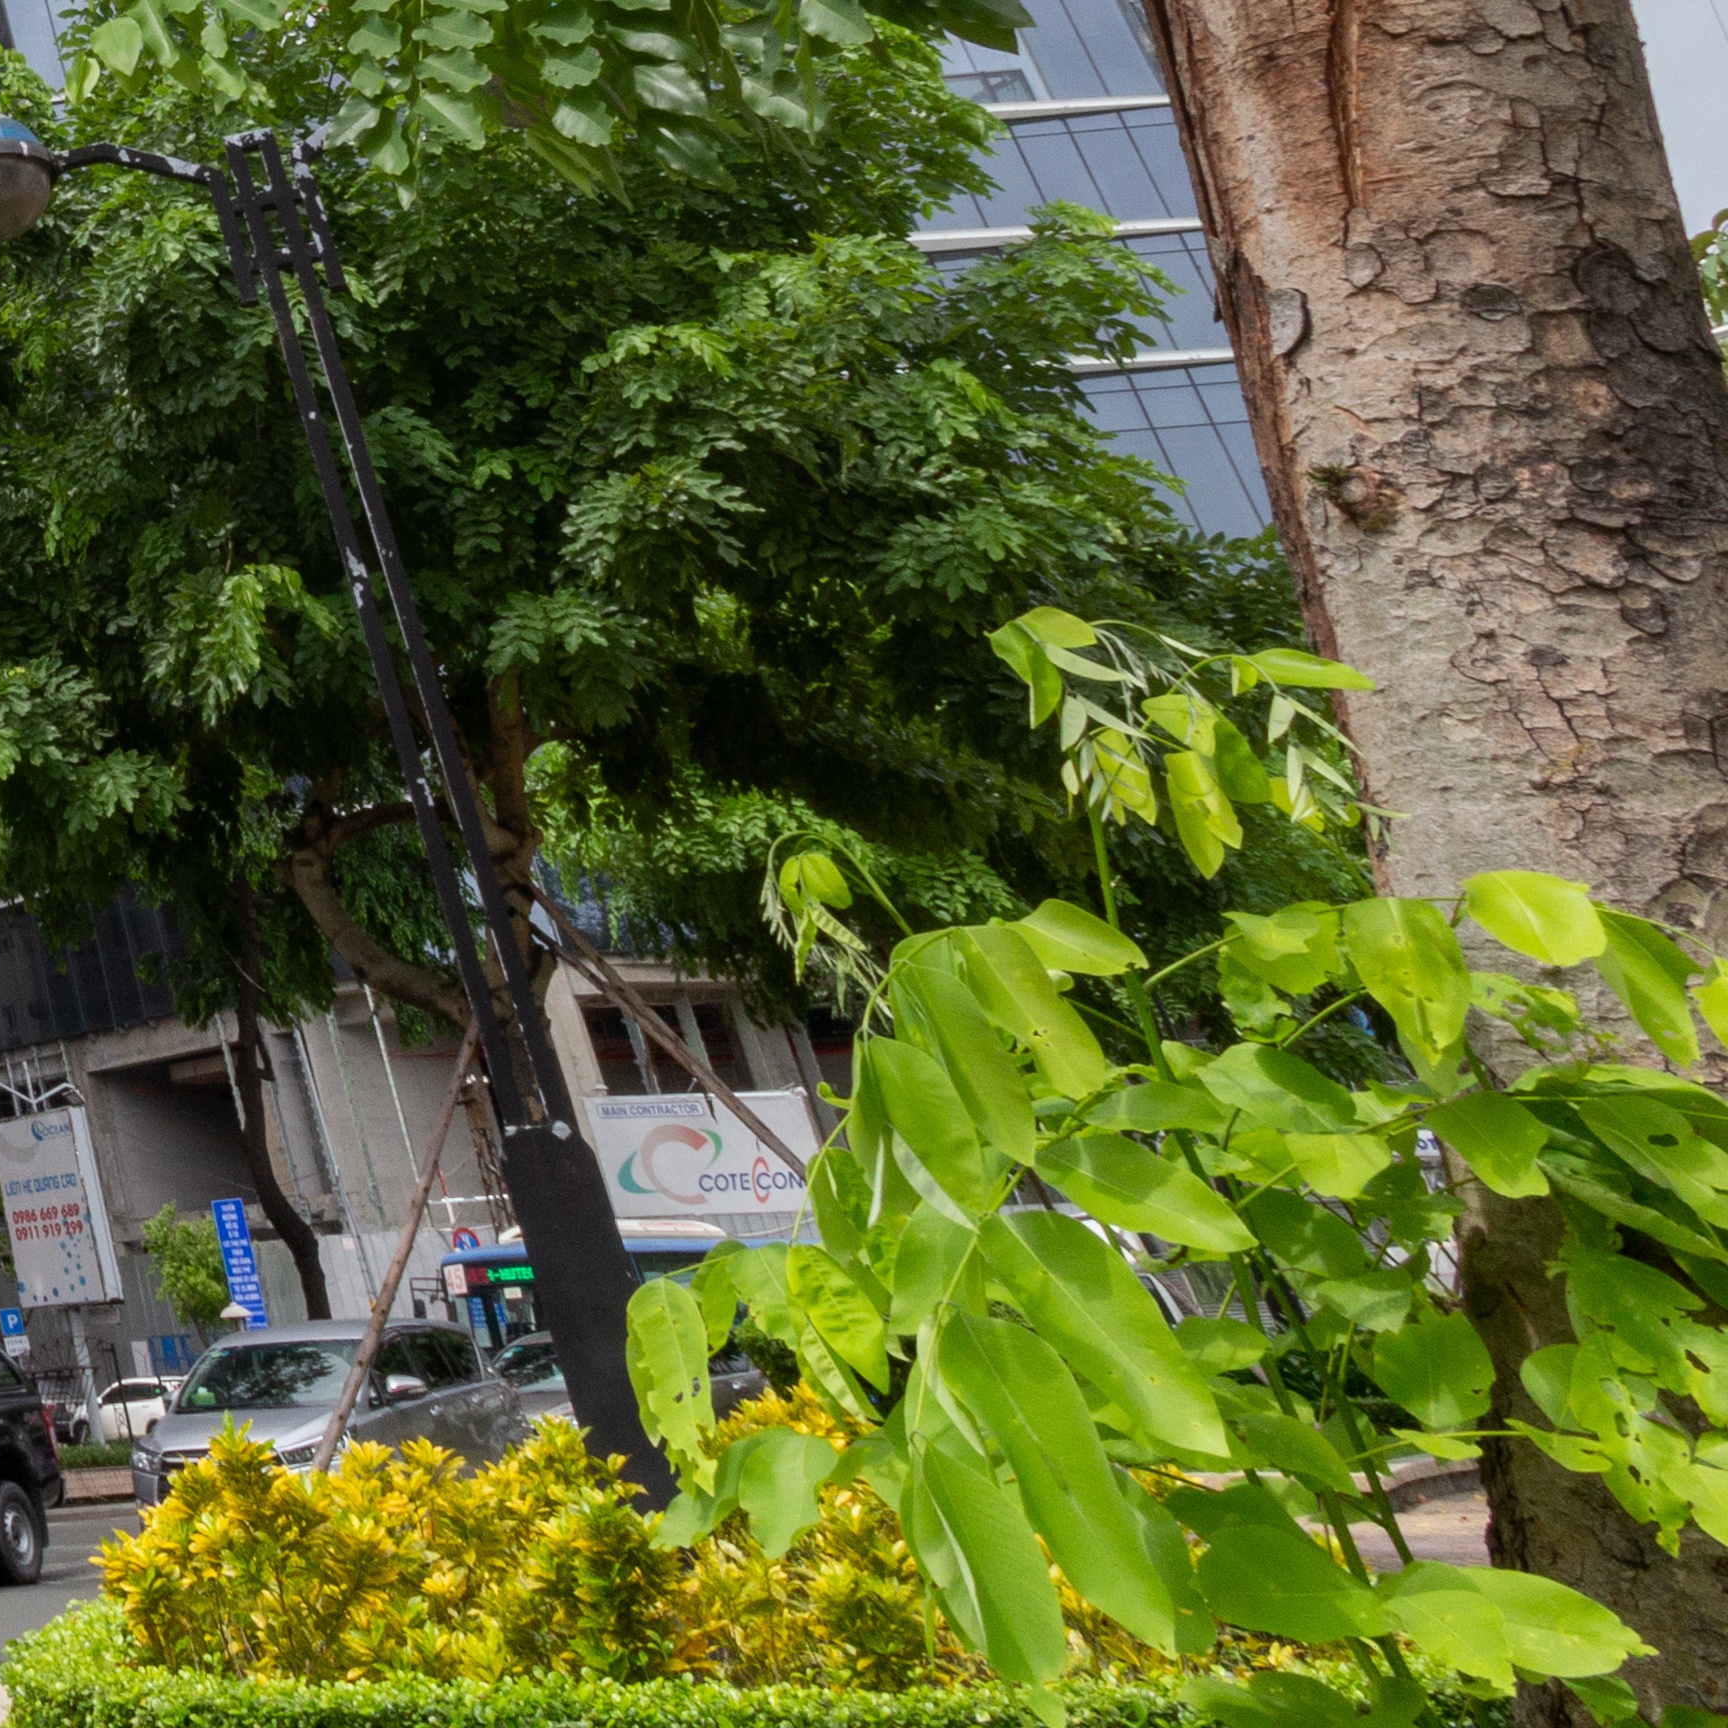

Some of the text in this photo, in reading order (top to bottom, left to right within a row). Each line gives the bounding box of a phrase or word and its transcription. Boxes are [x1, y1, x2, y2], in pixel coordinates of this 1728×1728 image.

[601, 1104, 699, 1117] MAIN CONTRACTOR
[12, 1202, 80, 1224] 0986 669 689
[15, 1225, 40, 1241] 0911
[42, 1222, 62, 1238] 919
[447, 1267, 464, 1290] 45
[7, 1314, 19, 1330] P
